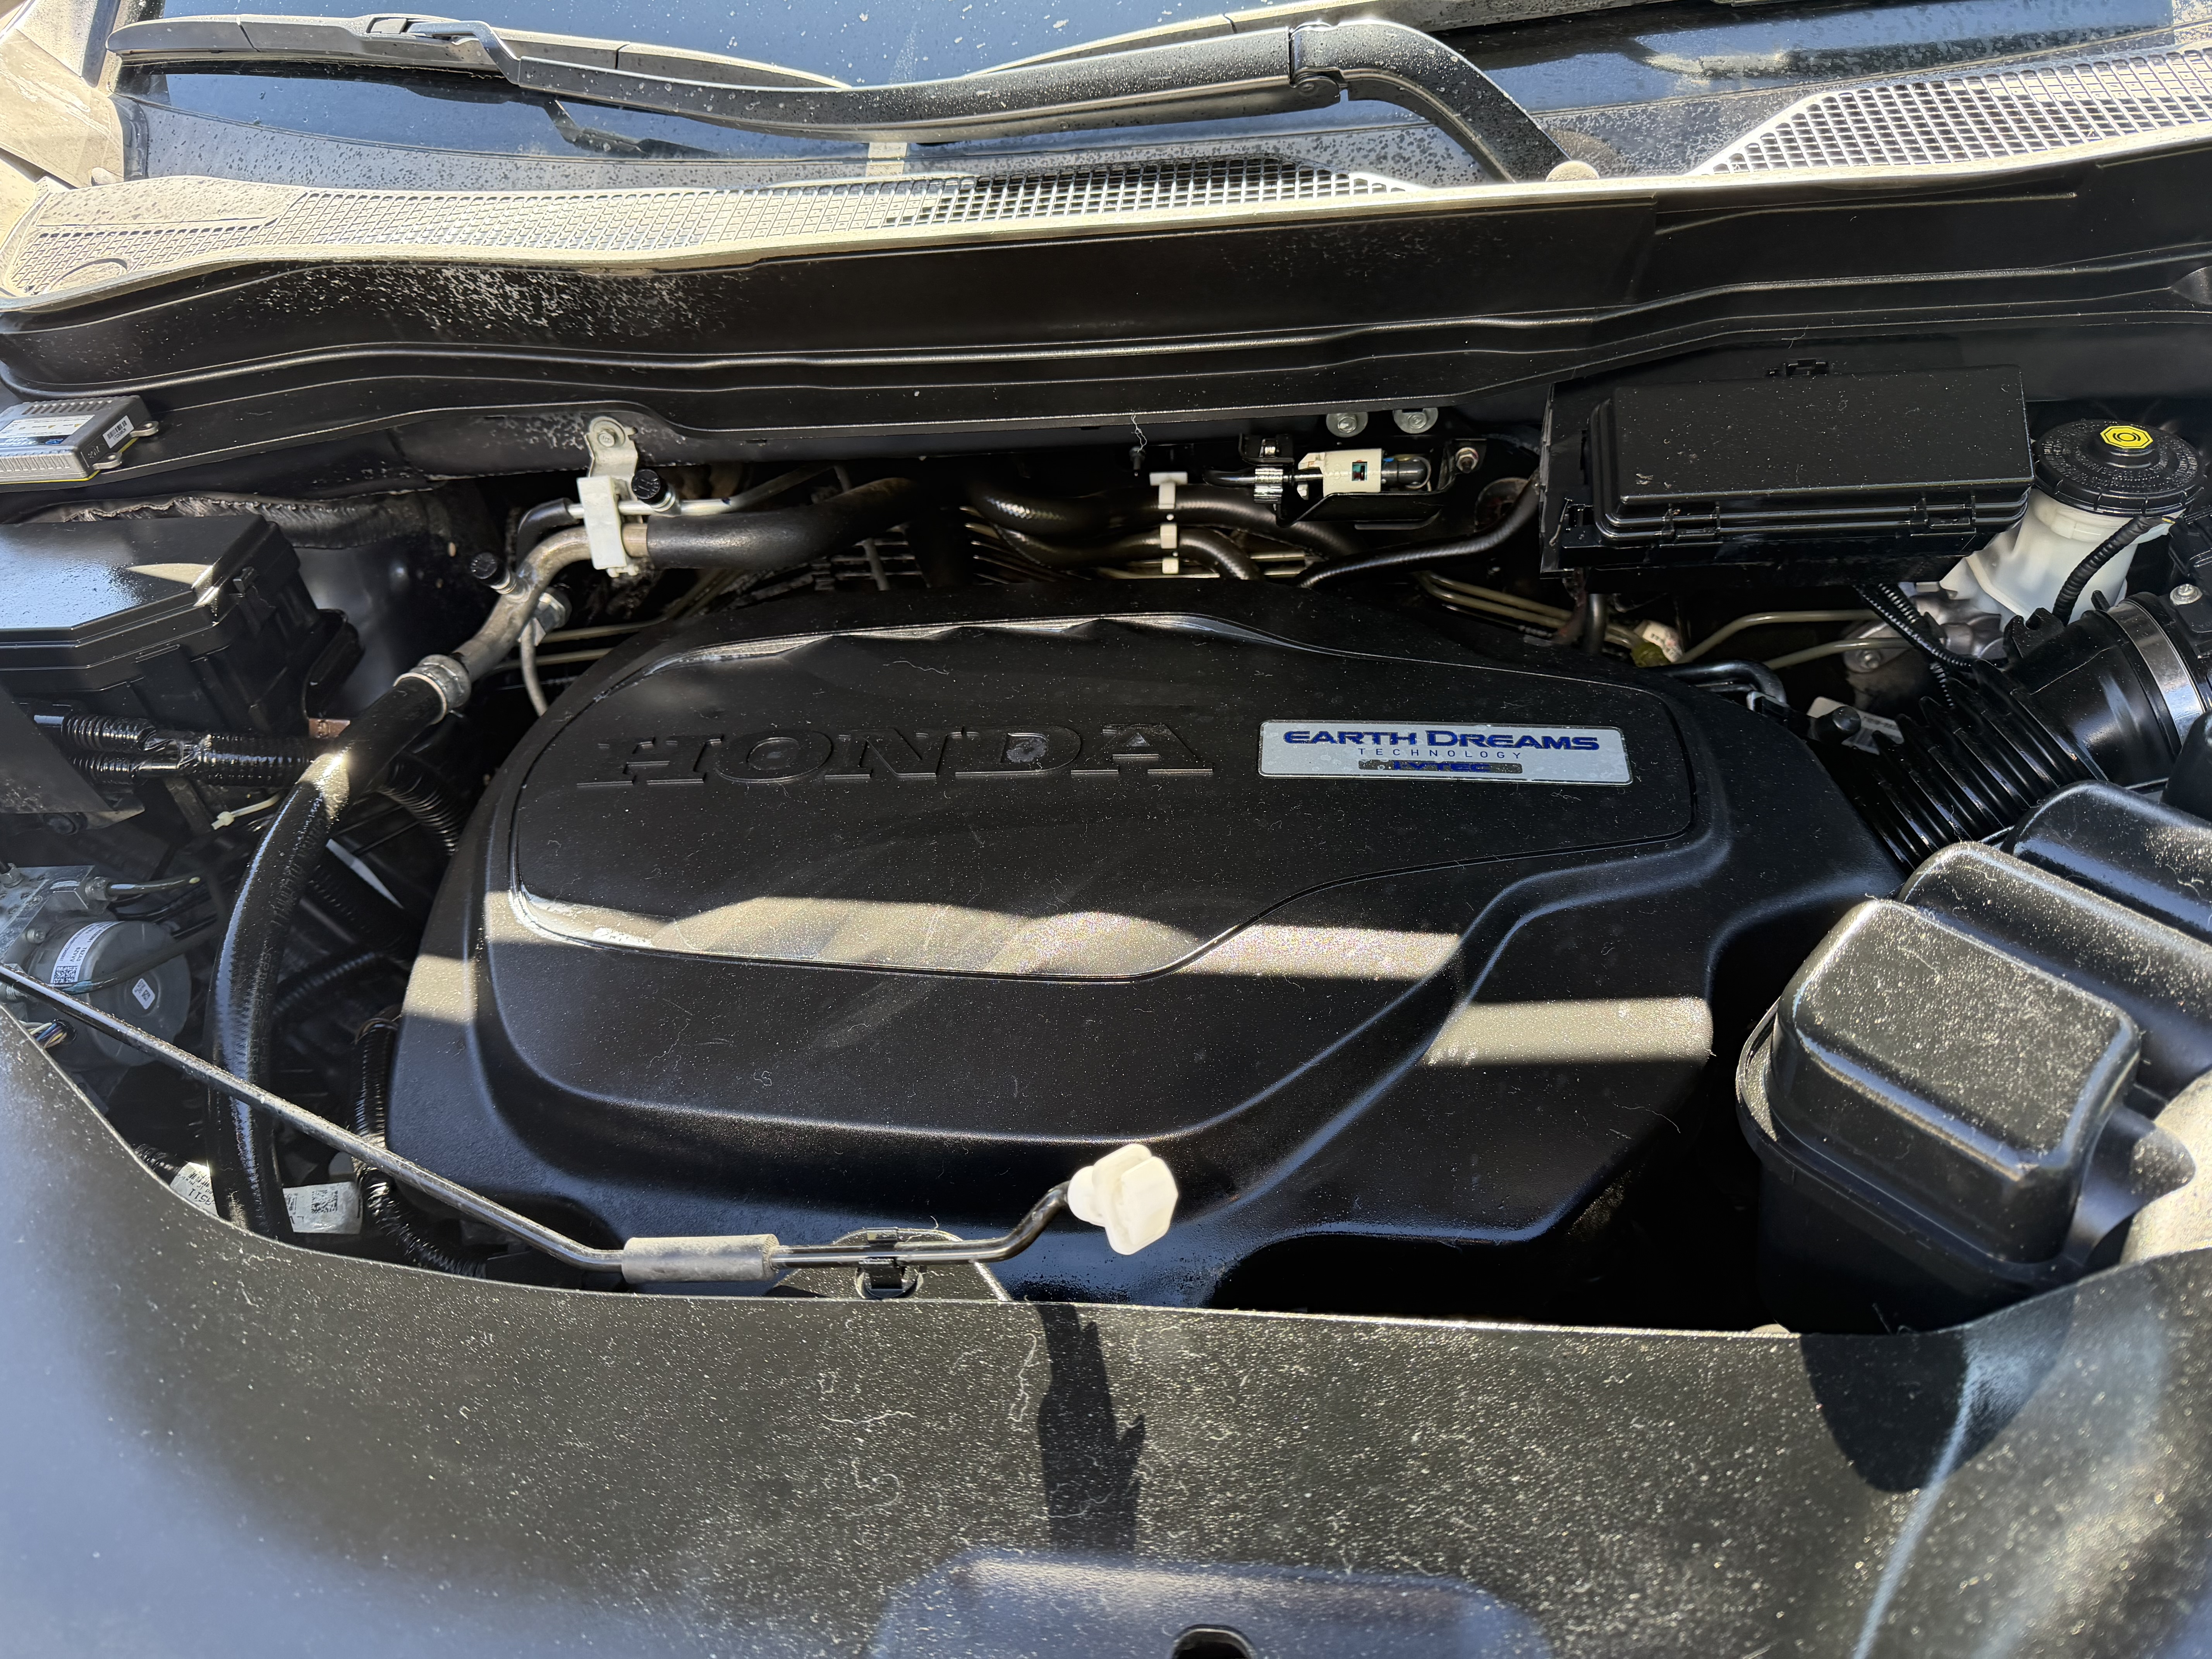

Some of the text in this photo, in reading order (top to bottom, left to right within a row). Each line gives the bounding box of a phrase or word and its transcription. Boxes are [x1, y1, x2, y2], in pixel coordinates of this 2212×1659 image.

[1283, 730, 1600, 750] EARTH DREAMS
[577, 723, 1214, 786] HONDA
[1358, 748, 1521, 759] TECHNOLOGY
